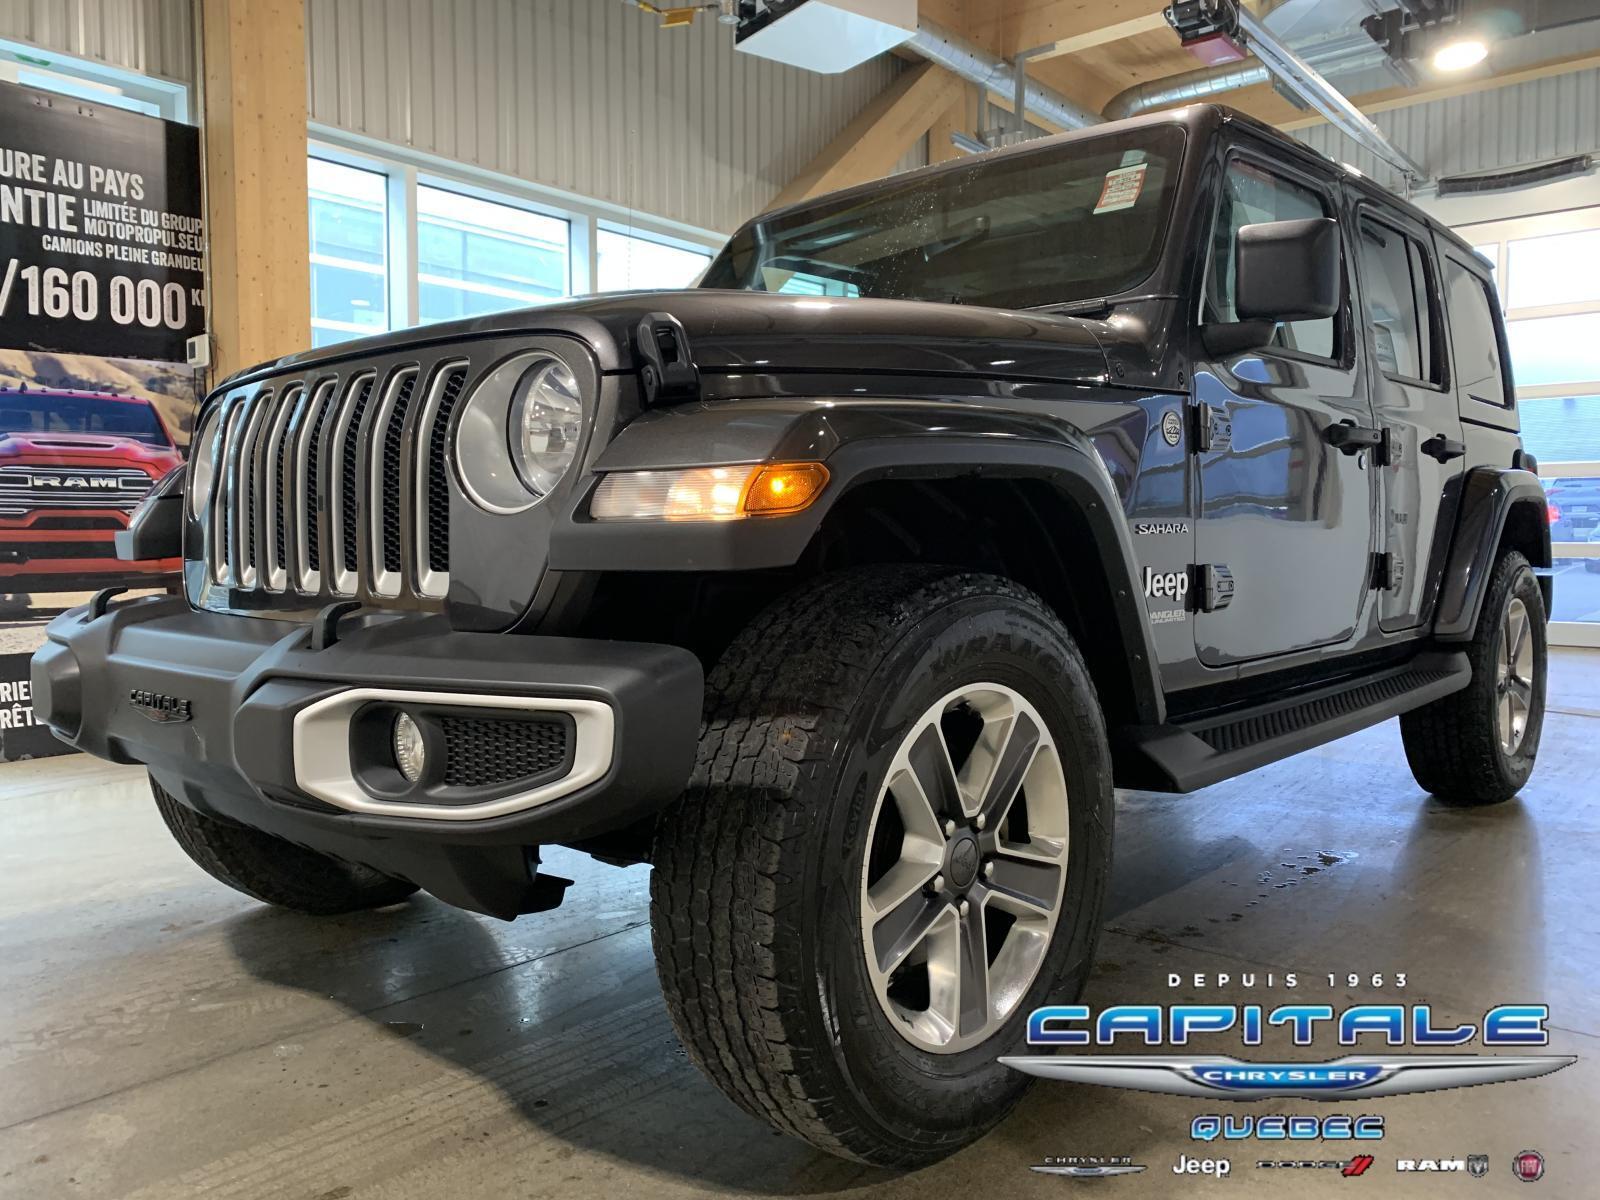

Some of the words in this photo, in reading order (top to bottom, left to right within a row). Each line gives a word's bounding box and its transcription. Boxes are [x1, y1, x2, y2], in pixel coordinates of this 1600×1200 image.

[0, 148, 46, 183] URE
[52, 158, 83, 189] AU
[90, 165, 144, 200] PAYS
[0, 184, 77, 232] NTIE
[83, 198, 137, 224] LIMITÉE
[140, 210, 159, 228] DU
[42, 234, 103, 258] CAMIONS
[106, 243, 149, 265] PLEINE
[110, 275, 187, 330] 000
[33, 475, 118, 489] RAM
[1137, 523, 1189, 535] SAHARA
[1143, 566, 1189, 601] Jeep
[1150, 608, 1186, 620] ANGLER
